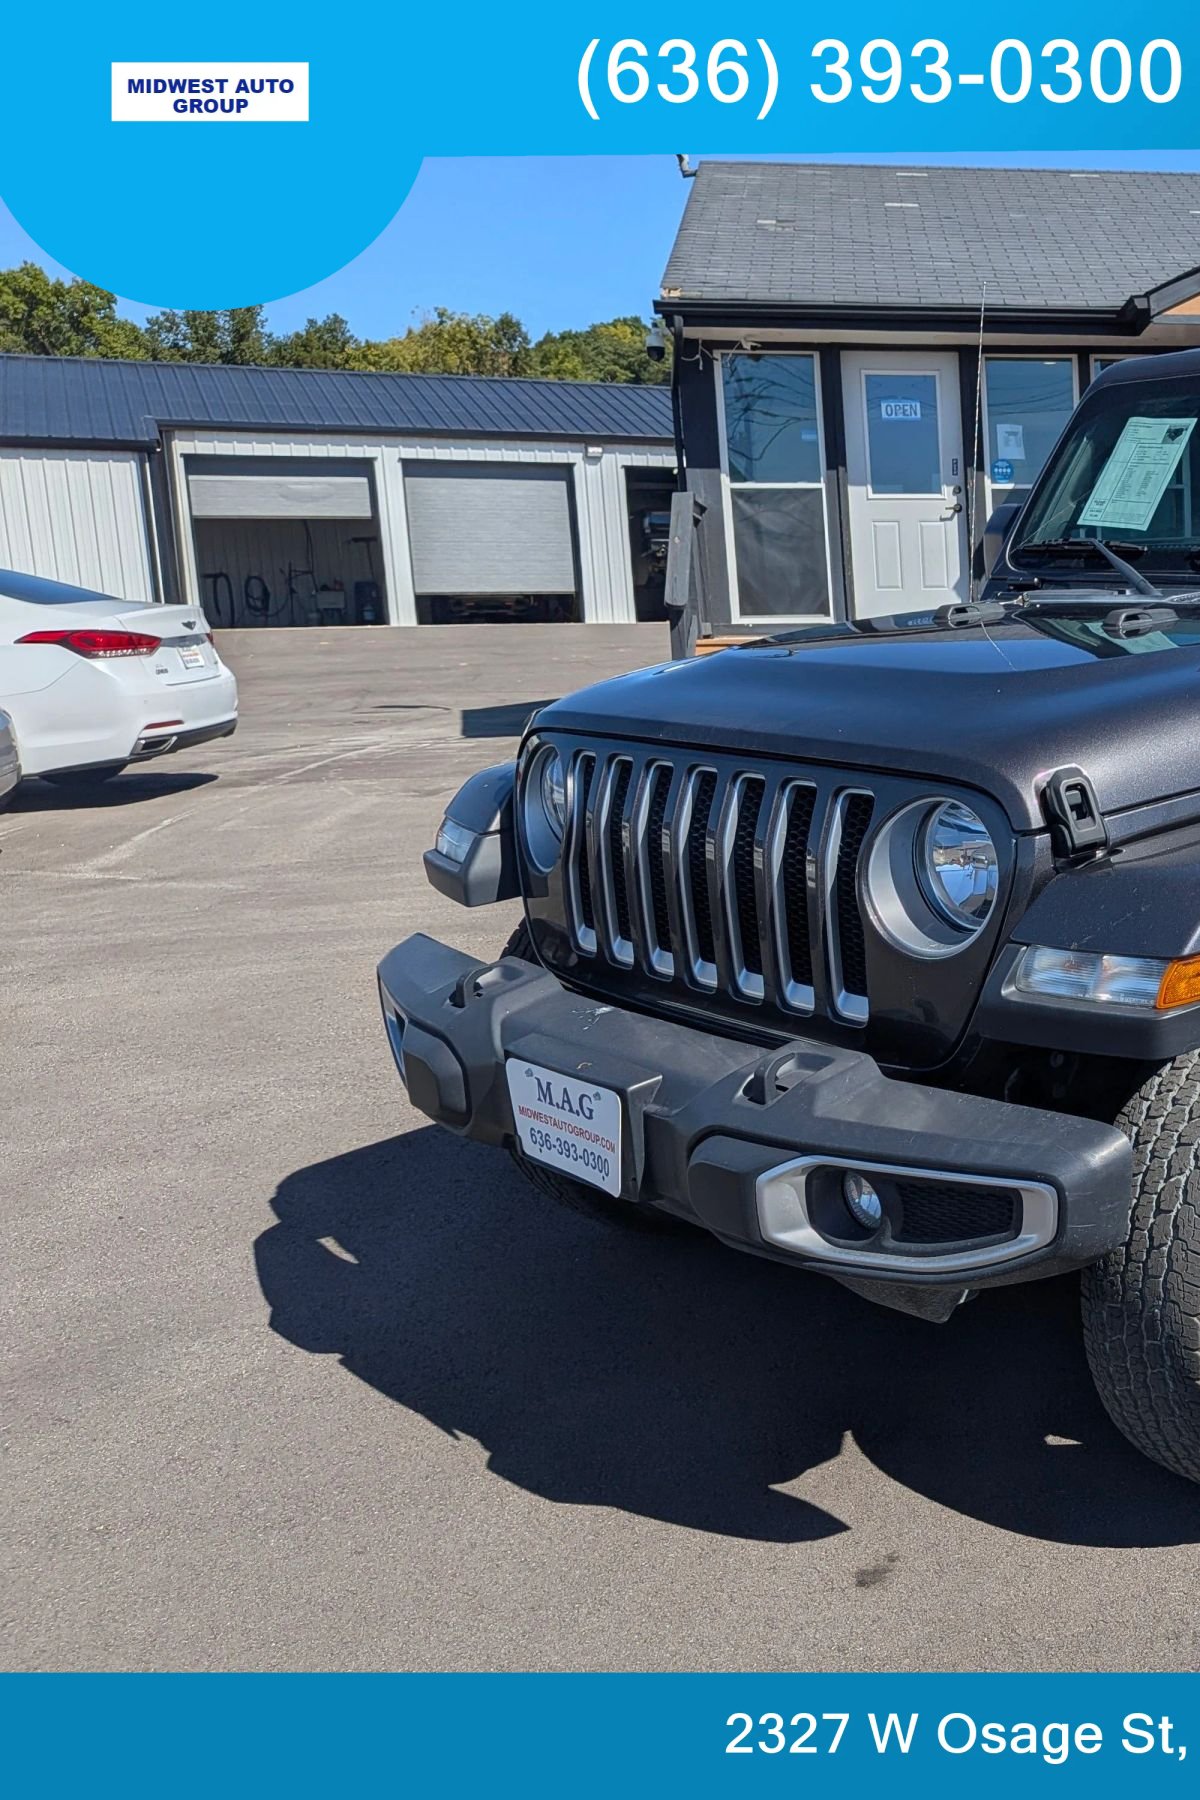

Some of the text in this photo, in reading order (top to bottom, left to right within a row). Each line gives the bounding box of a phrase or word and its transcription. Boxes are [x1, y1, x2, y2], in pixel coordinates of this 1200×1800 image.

[885, 404, 918, 417] OPEN
[534, 1076, 595, 1121] M.A.G
[518, 1105, 616, 1154] MIDWESTAUTOGROUP.COM
[529, 1127, 610, 1178] 636-393-0300
